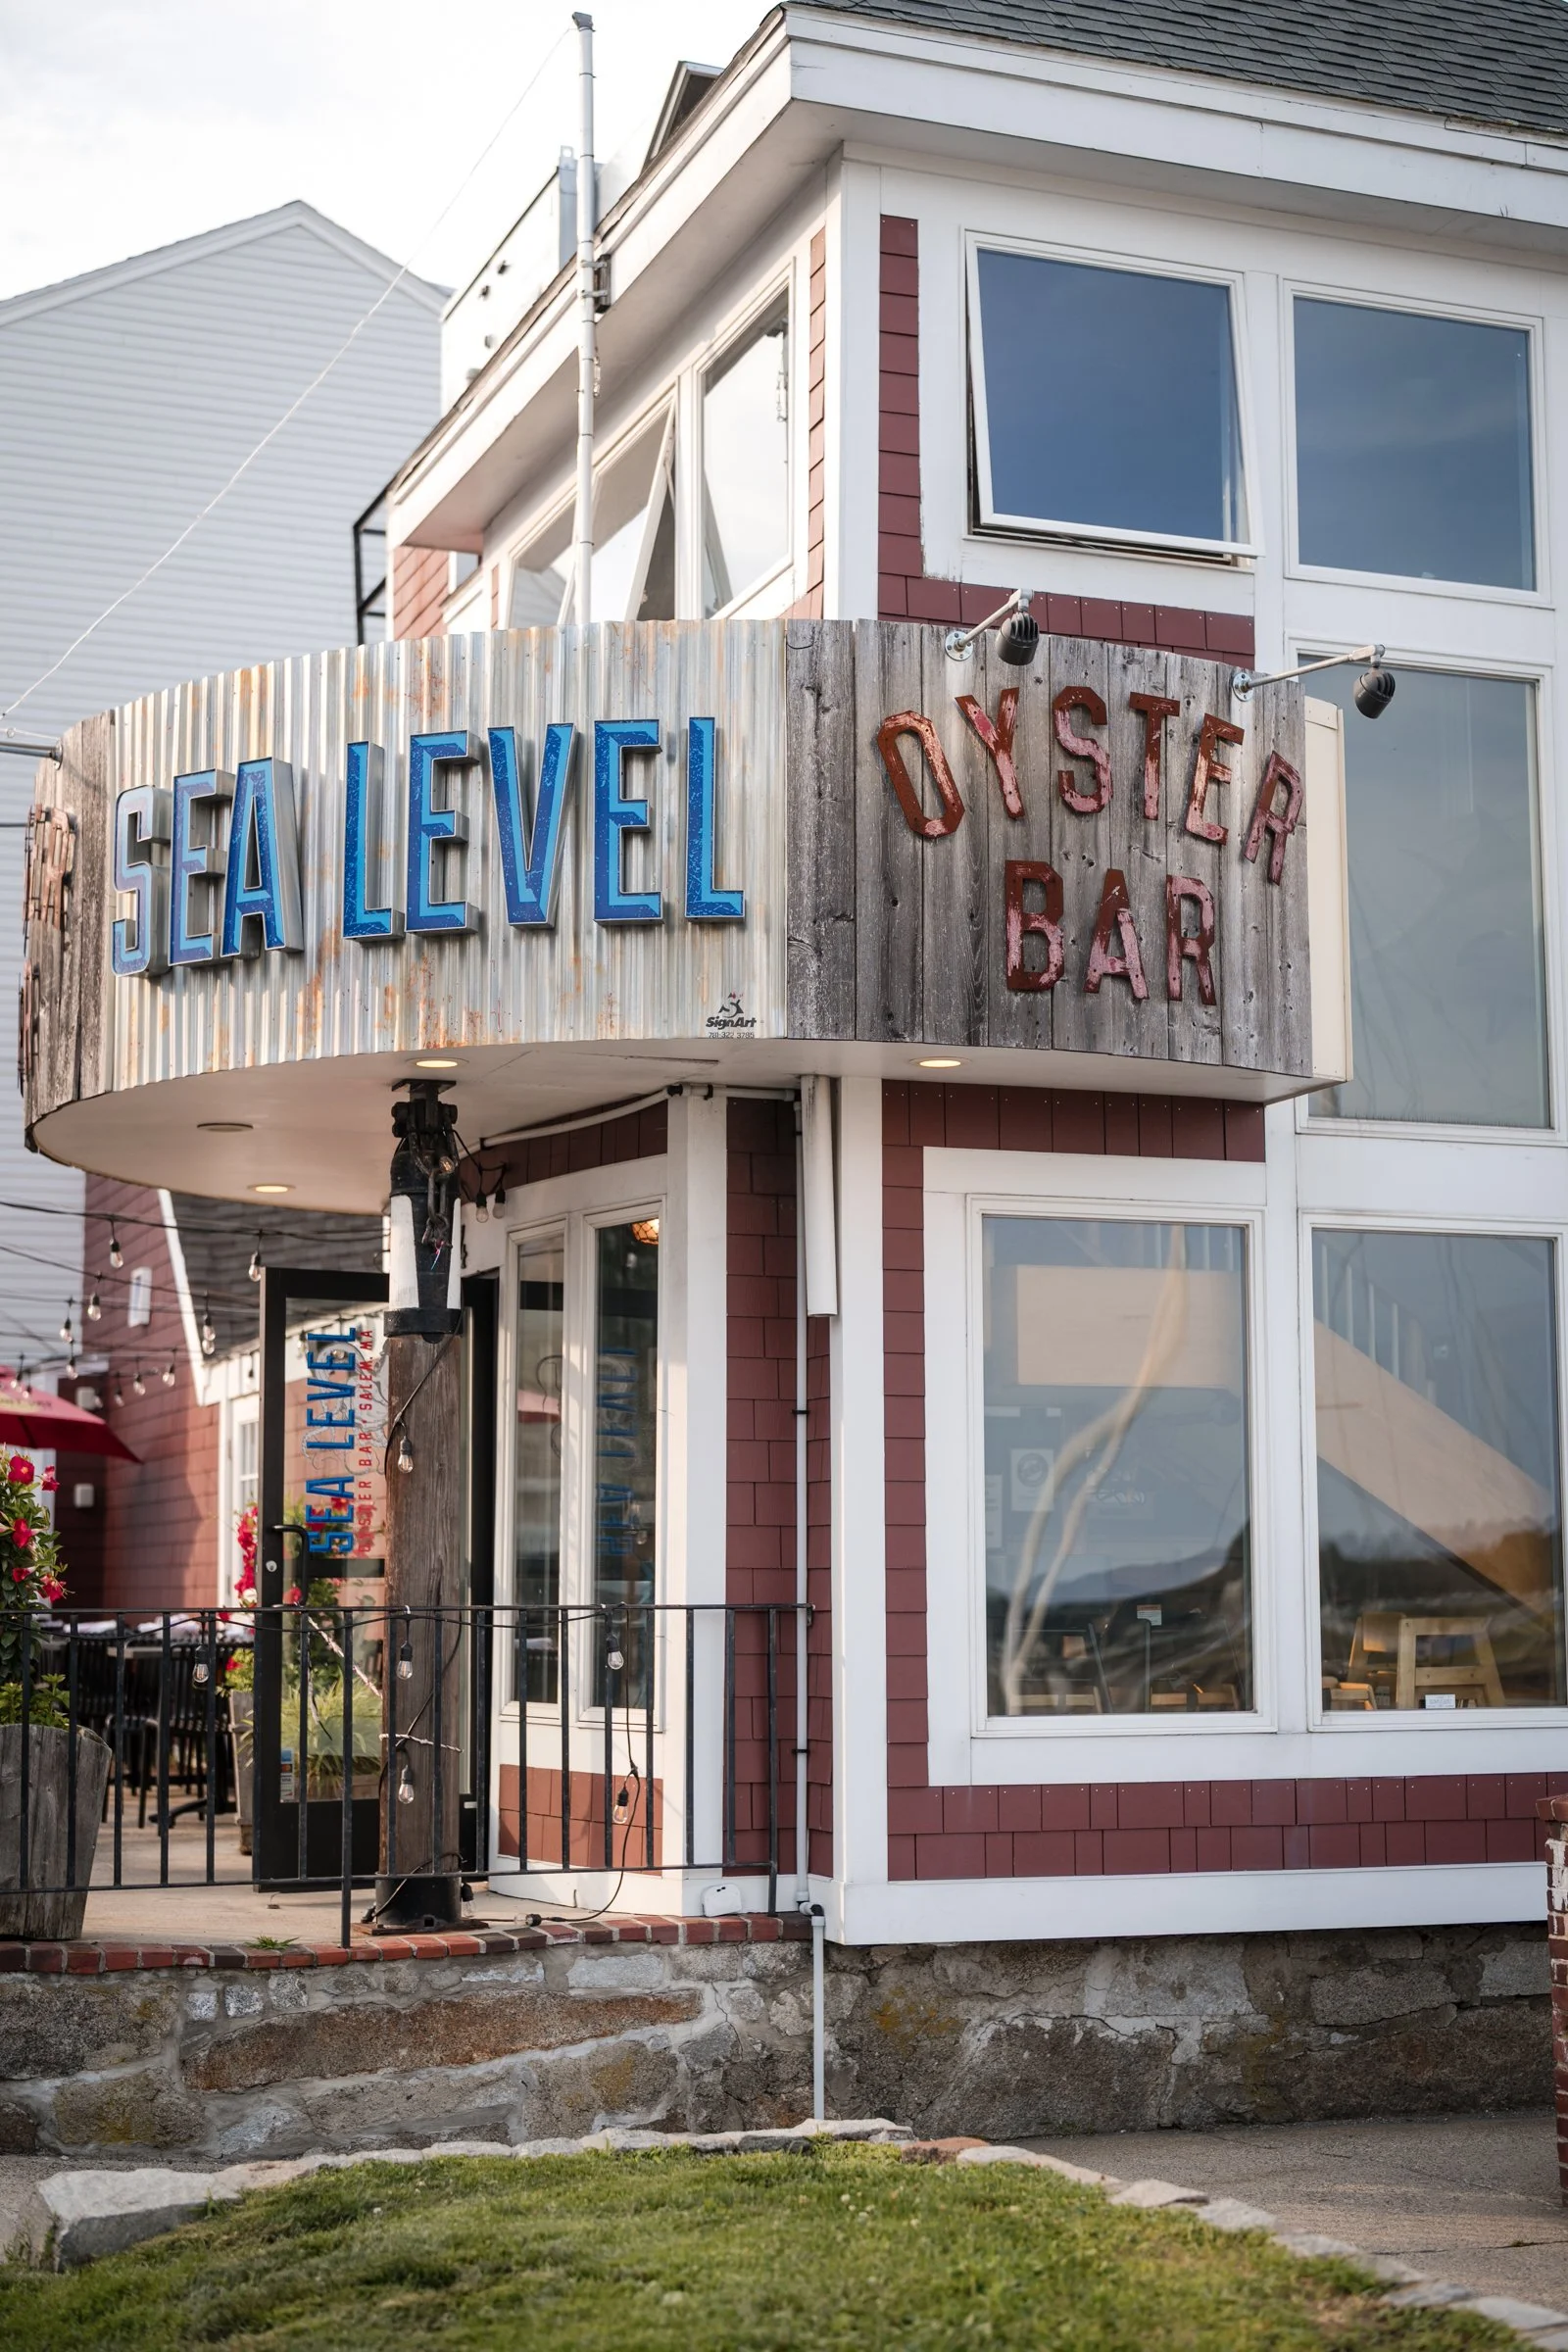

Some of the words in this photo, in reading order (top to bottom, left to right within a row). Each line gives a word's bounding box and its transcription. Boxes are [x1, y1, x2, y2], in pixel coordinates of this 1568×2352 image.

[877, 686, 1303, 886] OYSTER
[112, 758, 299, 978] SEA
[343, 716, 745, 942] LEVEL
[1004, 858, 1217, 1006] BAR
[706, 1015, 757, 1030] SignArt
[306, 1327, 356, 1450] LEVEL
[360, 1330, 373, 1350] MA
[359, 1432, 372, 1467] BAR
[306, 1476, 355, 1552] SEA
